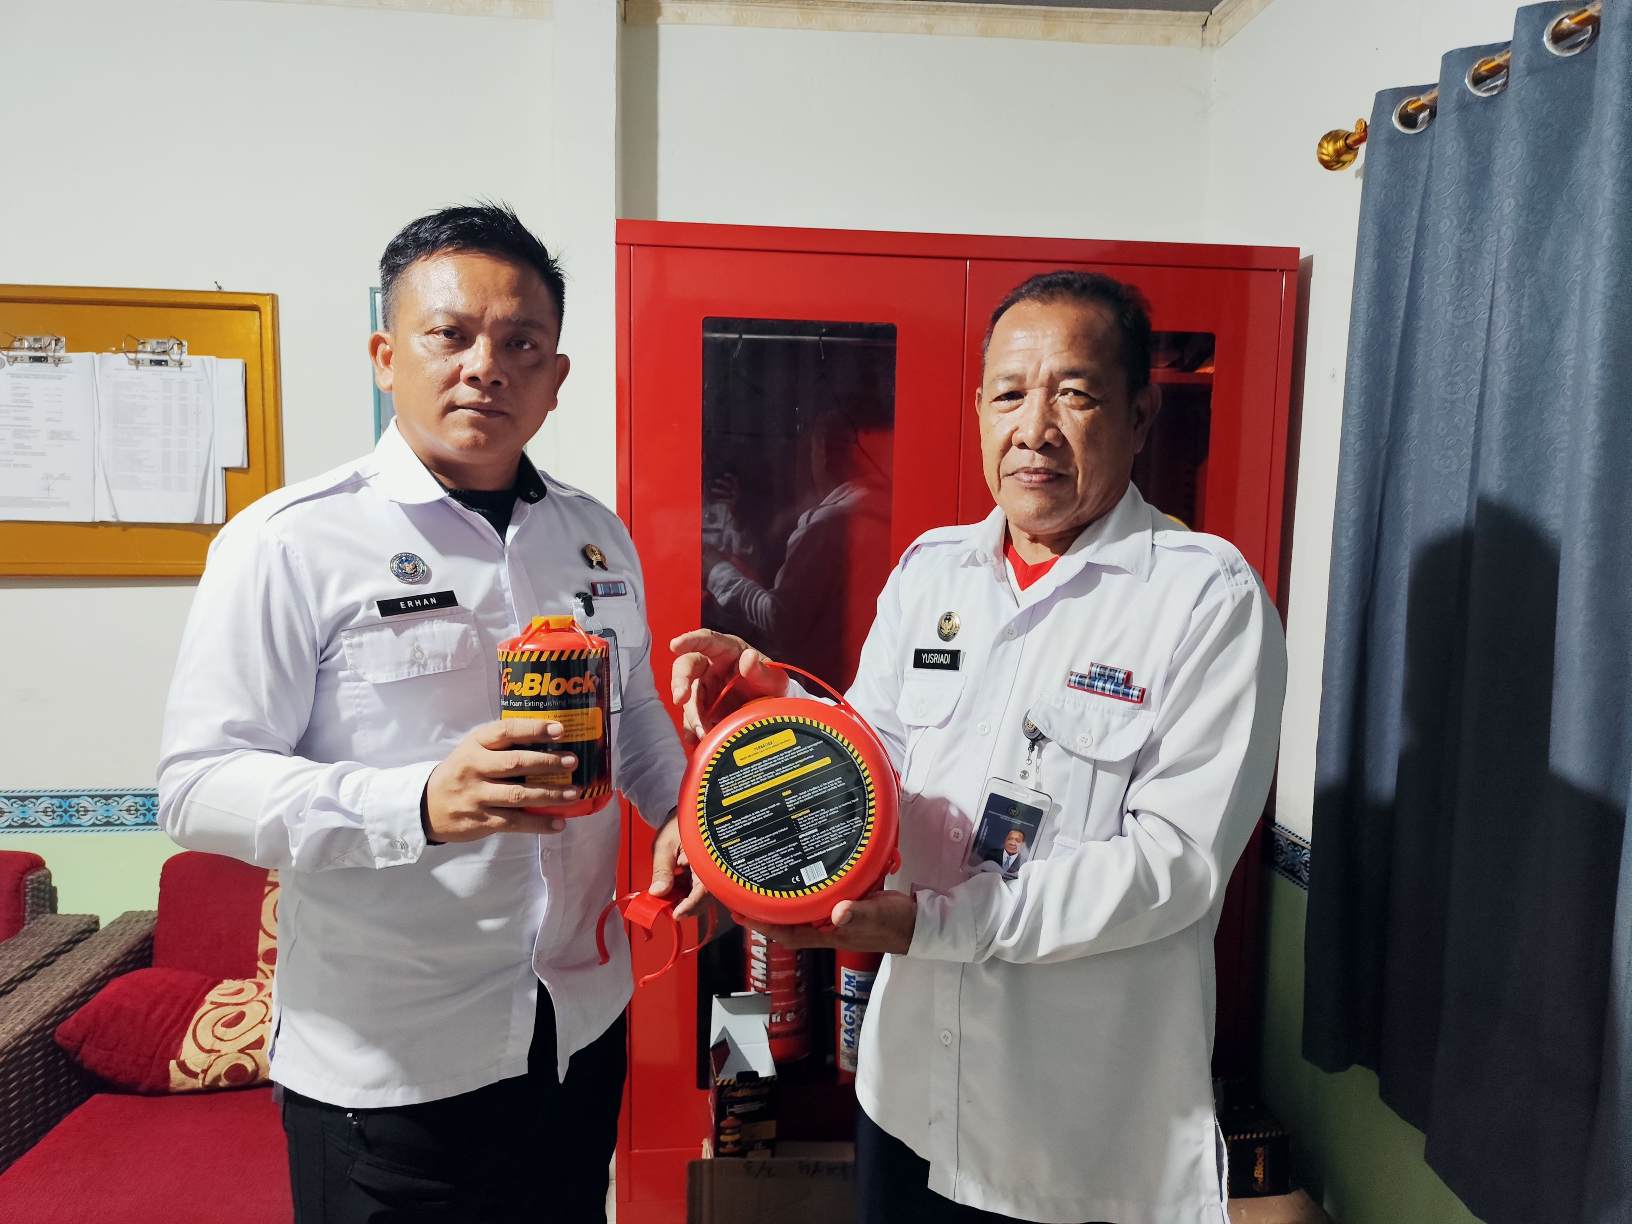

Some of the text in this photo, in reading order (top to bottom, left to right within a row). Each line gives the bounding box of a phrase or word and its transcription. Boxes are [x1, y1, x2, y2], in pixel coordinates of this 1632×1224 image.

[400, 597, 437, 609] ERHAN
[921, 653, 951, 665] YUSRIADI
[844, 972, 856, 1049] MAGNUM
